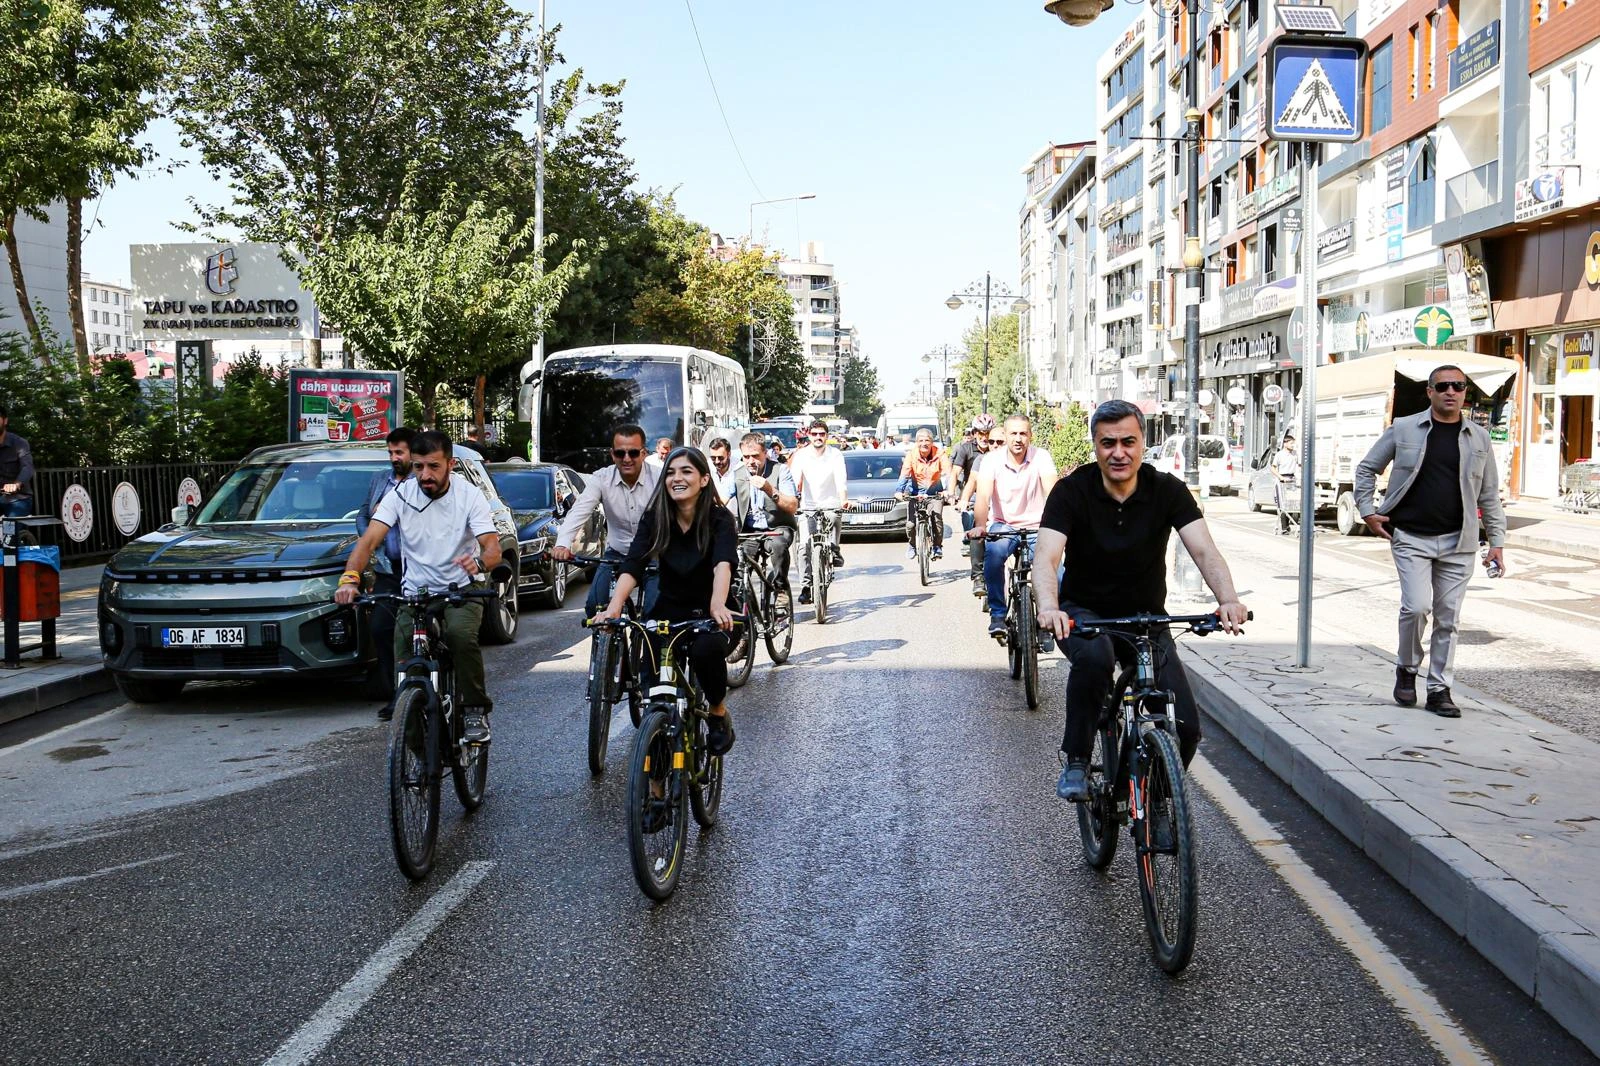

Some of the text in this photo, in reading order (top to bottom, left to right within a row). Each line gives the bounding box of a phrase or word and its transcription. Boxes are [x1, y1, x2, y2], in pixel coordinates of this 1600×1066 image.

[1460, 67, 1473, 83] ESRA
[1473, 56, 1491, 75] BAKAN
[143, 299, 298, 314] TAPU ve KADASTRO
[161, 319, 192, 330] (VAN)
[193, 318, 229, 329] BÖLGE
[230, 316, 300, 329] MÜDÜRLÜĞÜ
[1571, 359, 1584, 370] AVM
[300, 381, 391, 395] daha ucuzu yok!
[307, 417, 317, 425] A4
[170, 630, 184, 643] 06
[192, 630, 205, 643] AF
[216, 629, 243, 643] 1834
